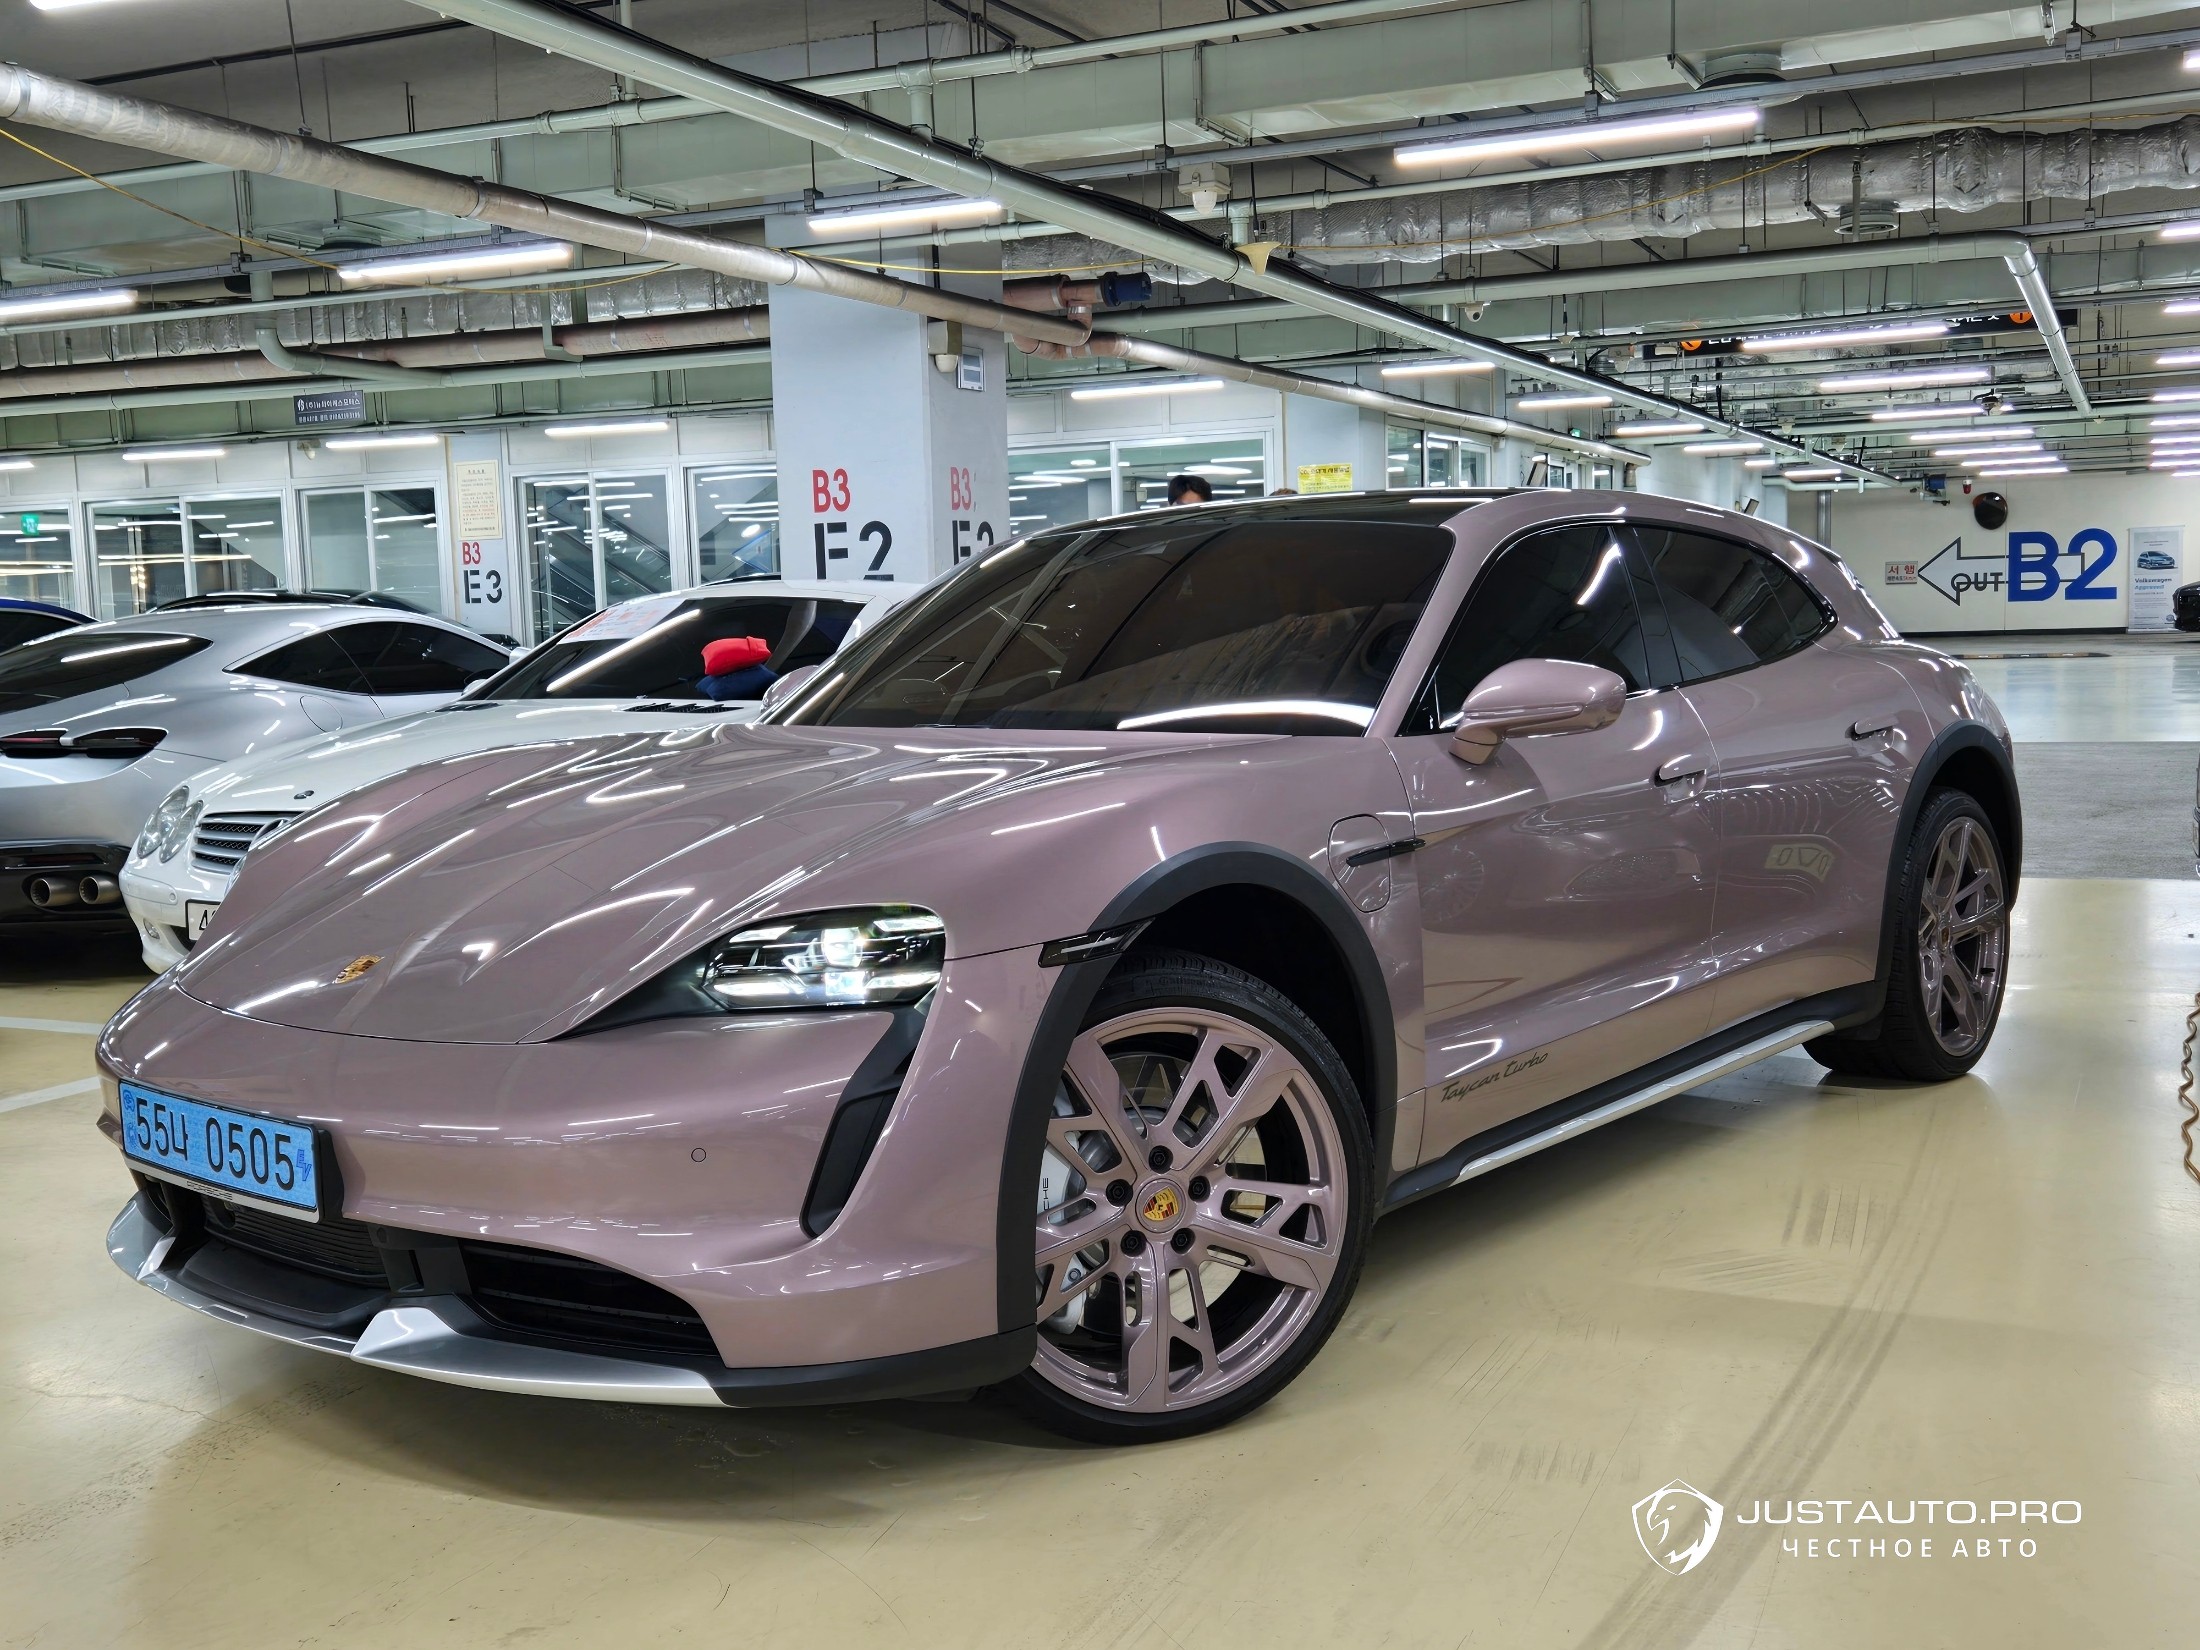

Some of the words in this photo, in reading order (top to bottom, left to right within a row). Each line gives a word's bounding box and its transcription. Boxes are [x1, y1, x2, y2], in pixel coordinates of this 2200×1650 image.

[813, 468, 851, 513] B3
[950, 466, 972, 511] B3
[462, 541, 481, 565] B3
[2008, 527, 2117, 602] B2
[463, 569, 502, 604] E3
[1951, 572, 2003, 593] OUT
[1441, 1071, 1500, 1103] Taycan
[1503, 1051, 1549, 1078] turbo
[205, 1117, 295, 1191] 0505
